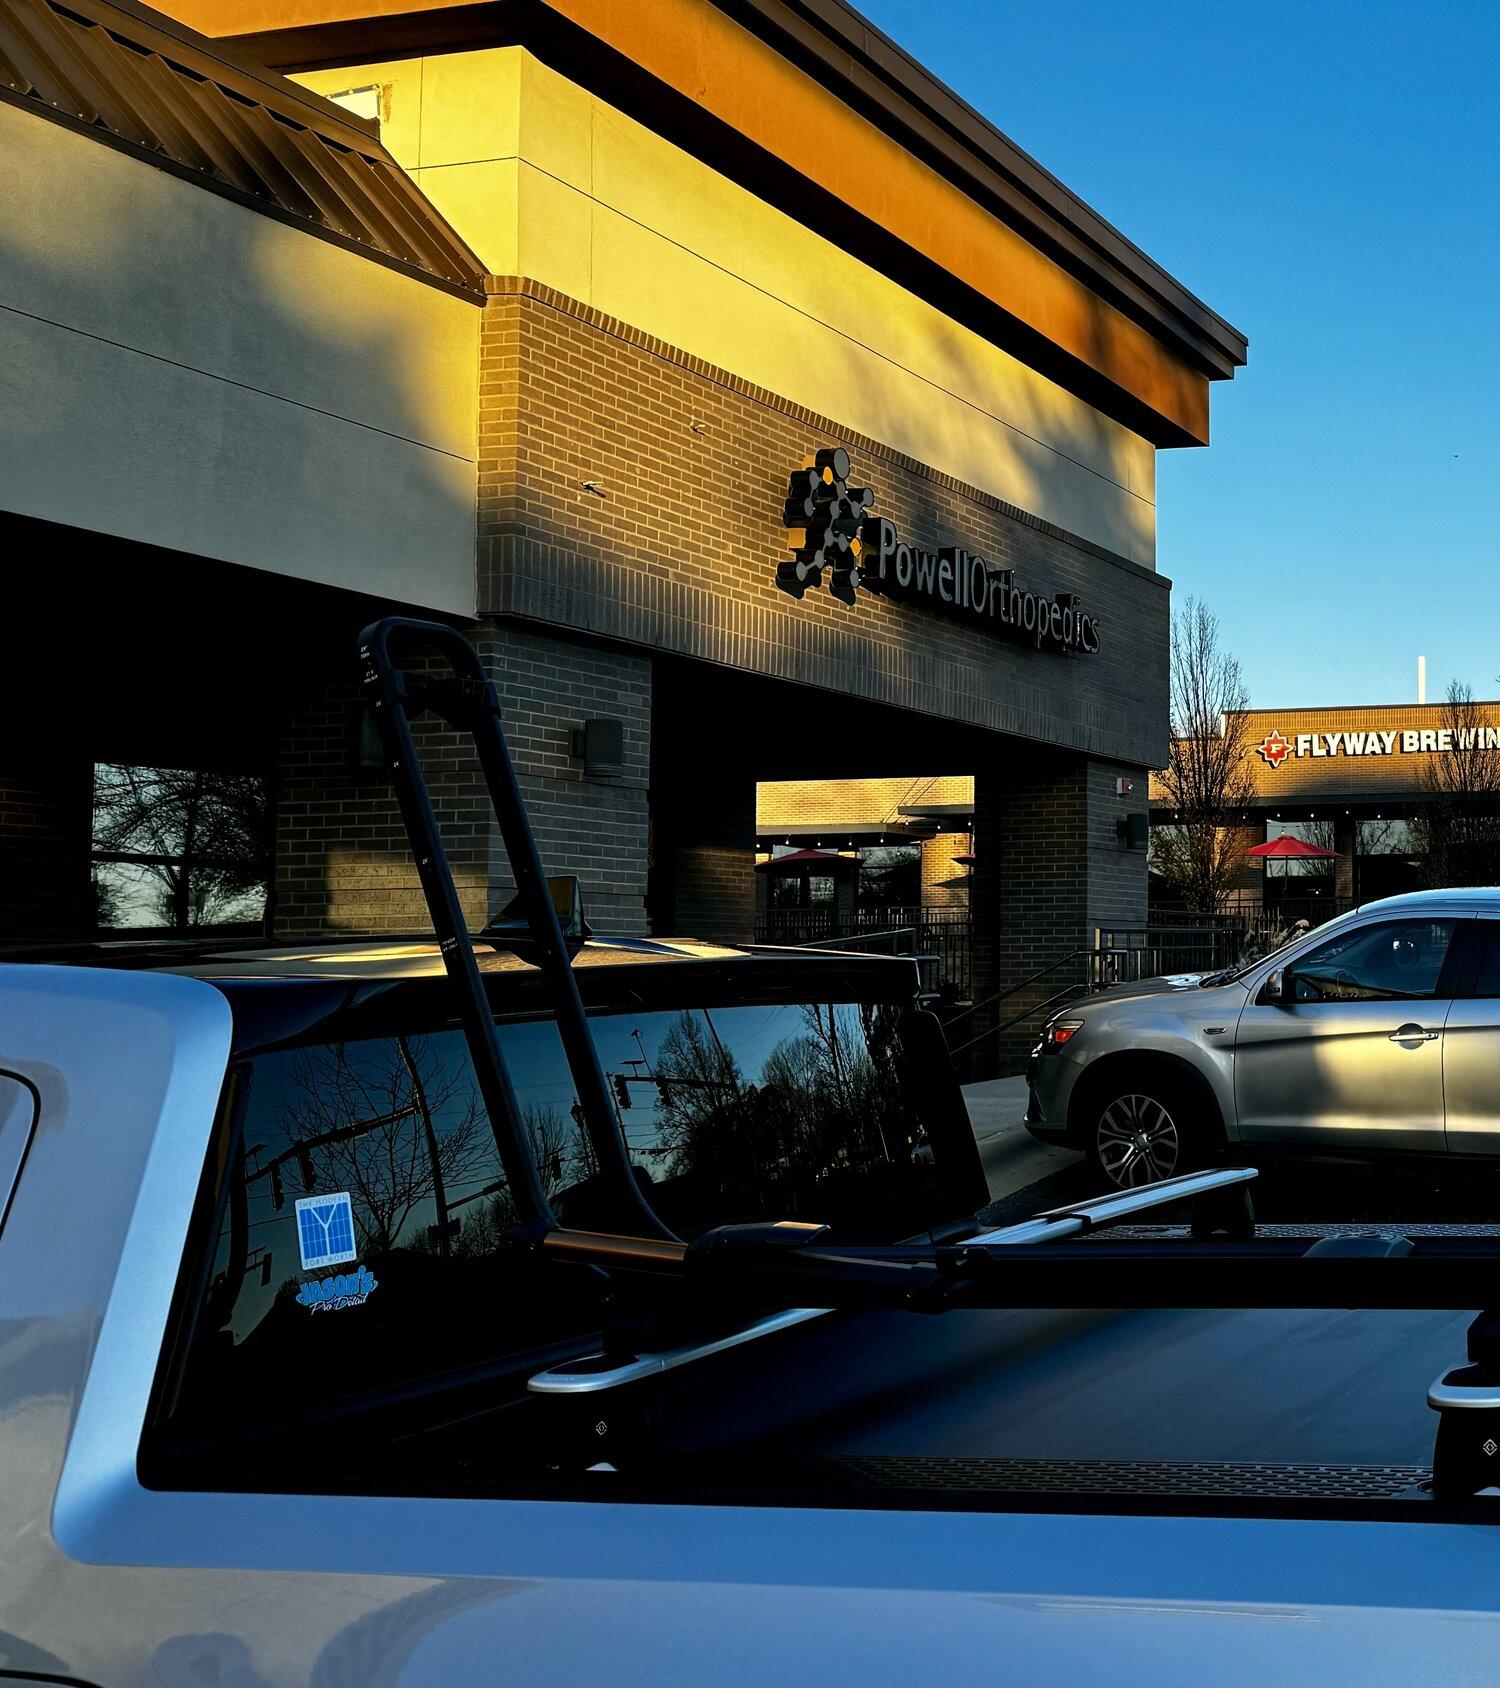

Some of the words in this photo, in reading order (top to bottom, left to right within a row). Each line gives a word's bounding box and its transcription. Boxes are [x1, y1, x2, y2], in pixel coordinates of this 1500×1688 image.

[1296, 730, 1399, 757] FLYWAY
[305, 1257, 324, 1267] FORT
[327, 1253, 354, 1262] WORTH
[296, 1265, 378, 1306] JASON'S
